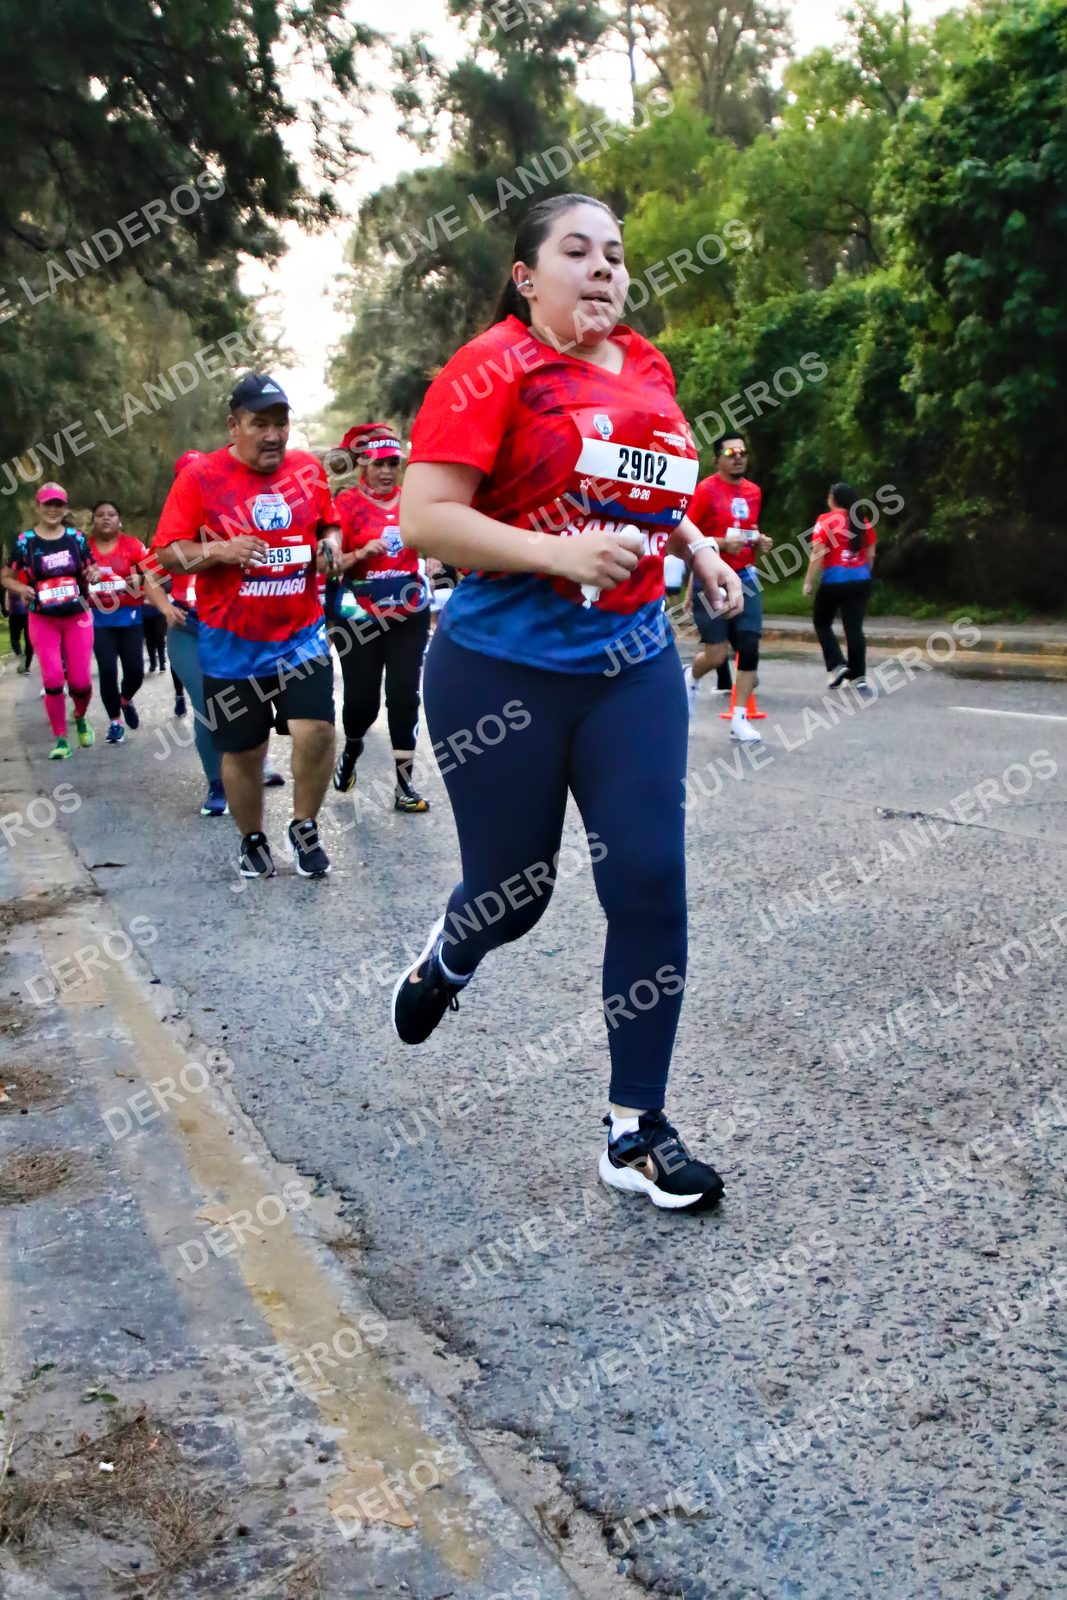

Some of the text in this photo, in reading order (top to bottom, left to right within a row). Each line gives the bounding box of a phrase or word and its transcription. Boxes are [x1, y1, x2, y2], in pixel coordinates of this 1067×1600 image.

[617, 447, 667, 487] 2902
[261, 548, 292, 565] 593
[238, 577, 307, 597] SANTIAGO
